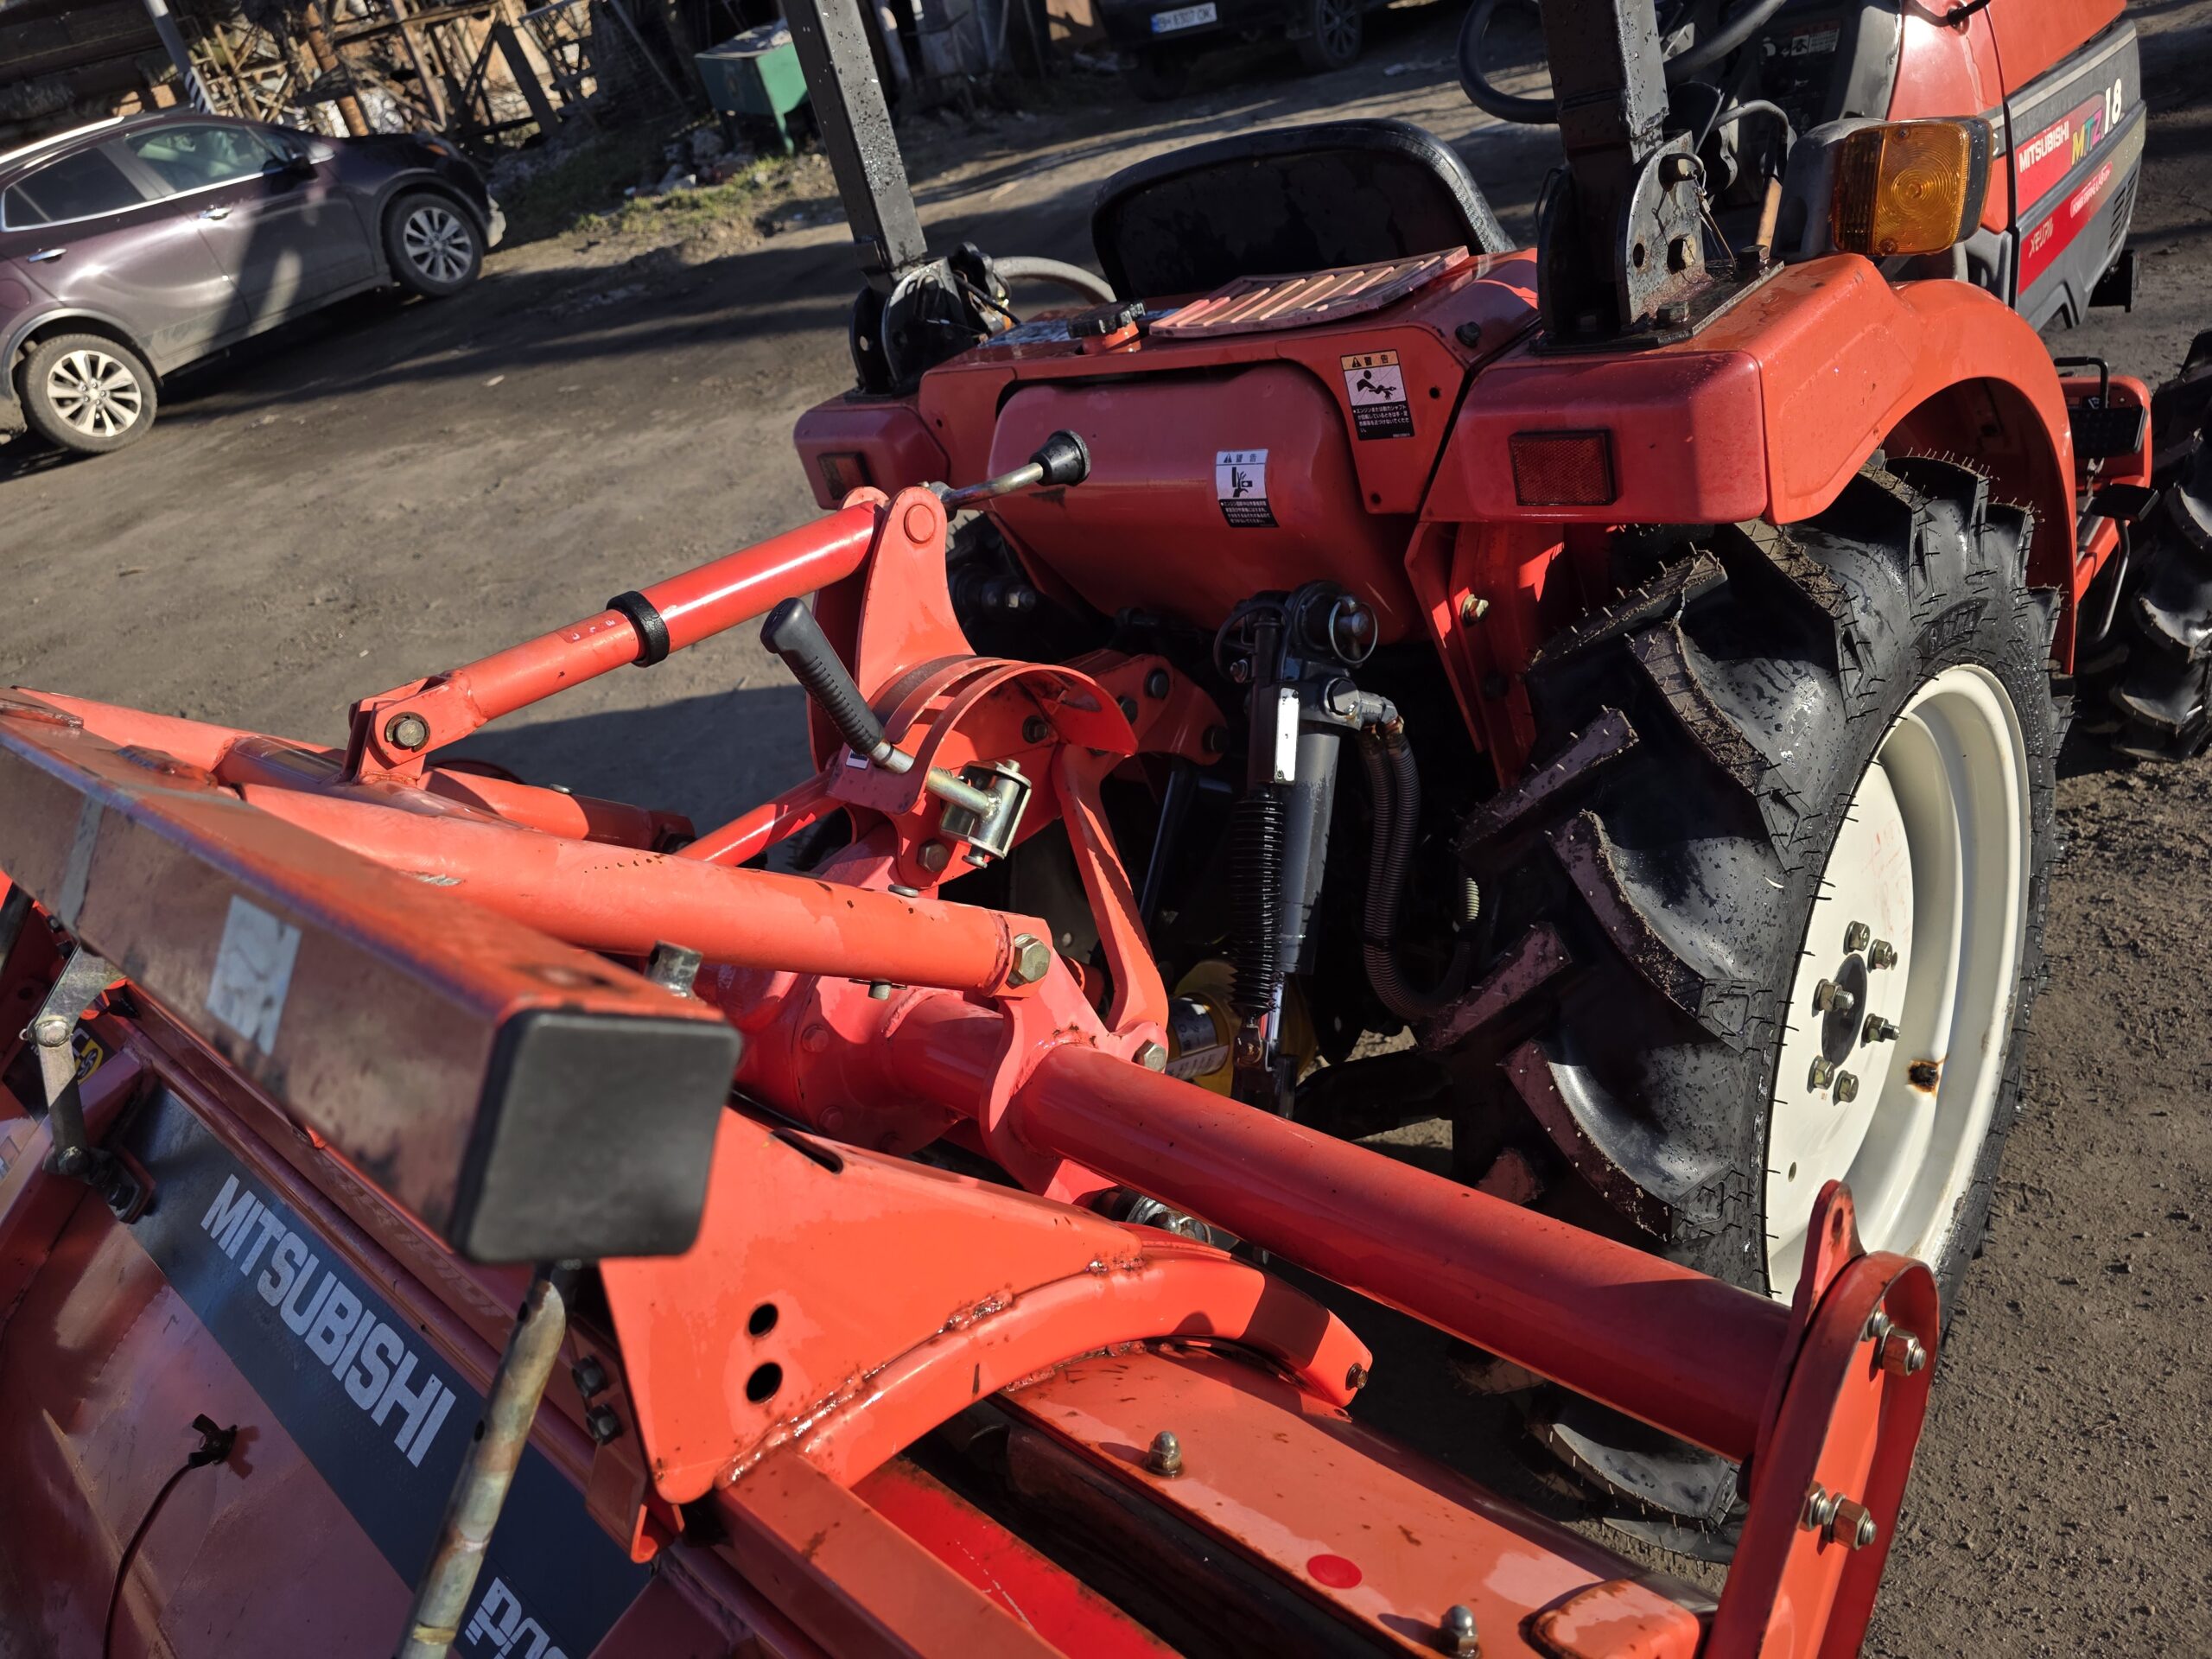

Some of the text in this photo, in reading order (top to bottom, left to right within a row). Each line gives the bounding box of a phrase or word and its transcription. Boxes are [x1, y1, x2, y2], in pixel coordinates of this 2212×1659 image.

[2019, 78, 2122, 173] MITSUBISHI MTZ 18
[200, 1174, 456, 1468] MITSUBISHI
